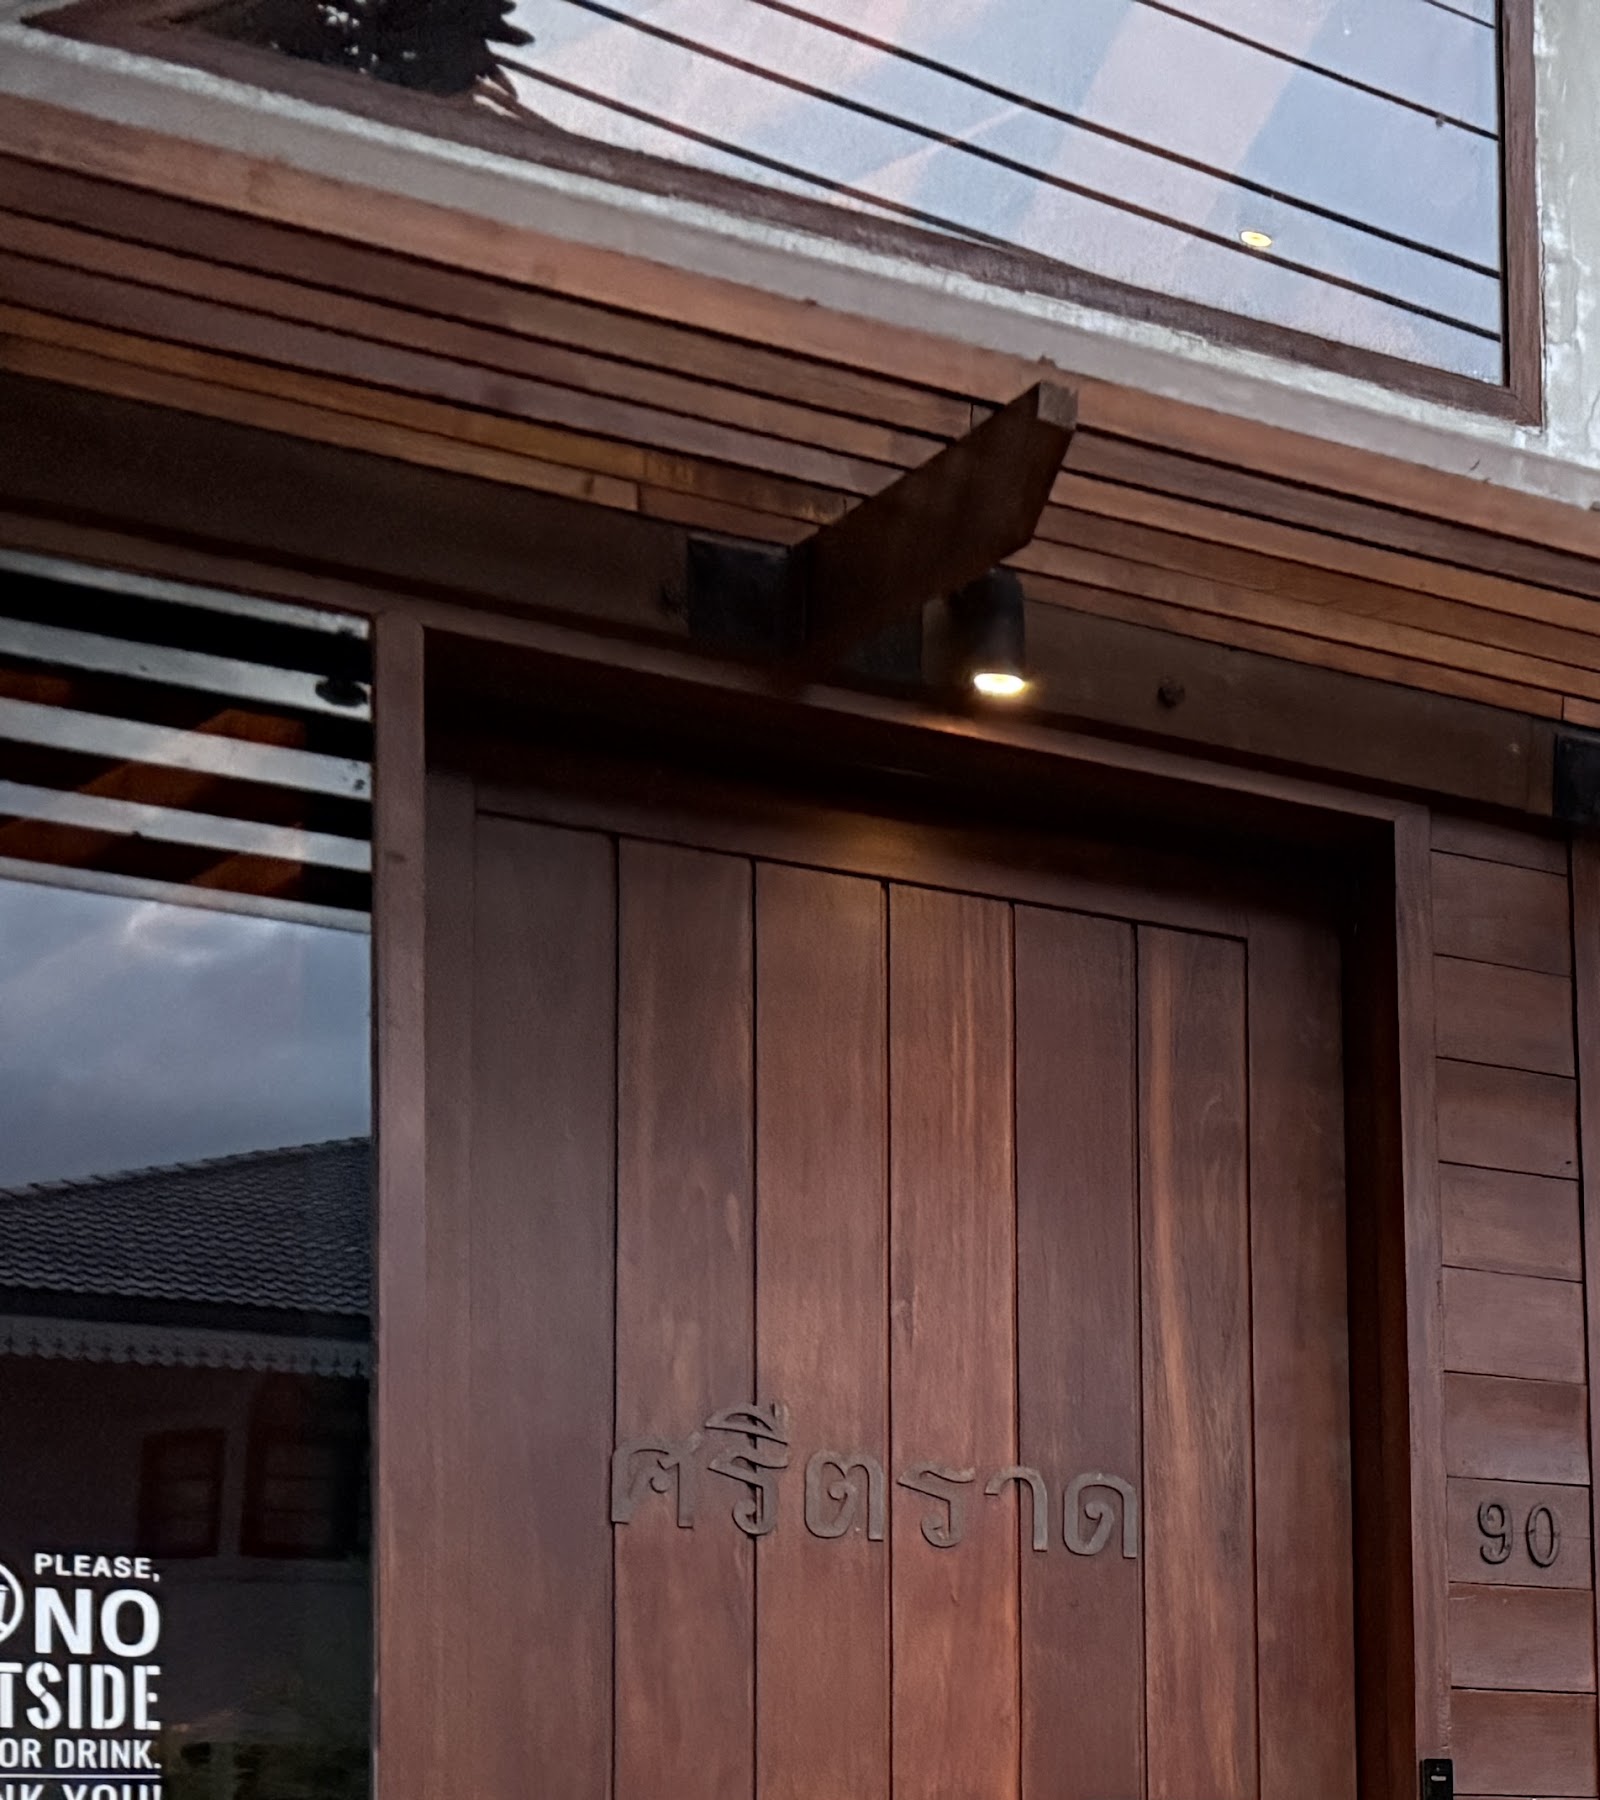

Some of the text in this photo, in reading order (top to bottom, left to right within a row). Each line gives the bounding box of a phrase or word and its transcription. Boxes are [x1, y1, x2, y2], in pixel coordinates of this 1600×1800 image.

[610, 1399, 1138, 1559] ศรีตราด
[34, 1552, 161, 1582] PLEASE,
[1477, 1501, 1561, 1568] 90
[34, 1586, 160, 1658] NO
[54, 1738, 162, 1769] DRINK.
